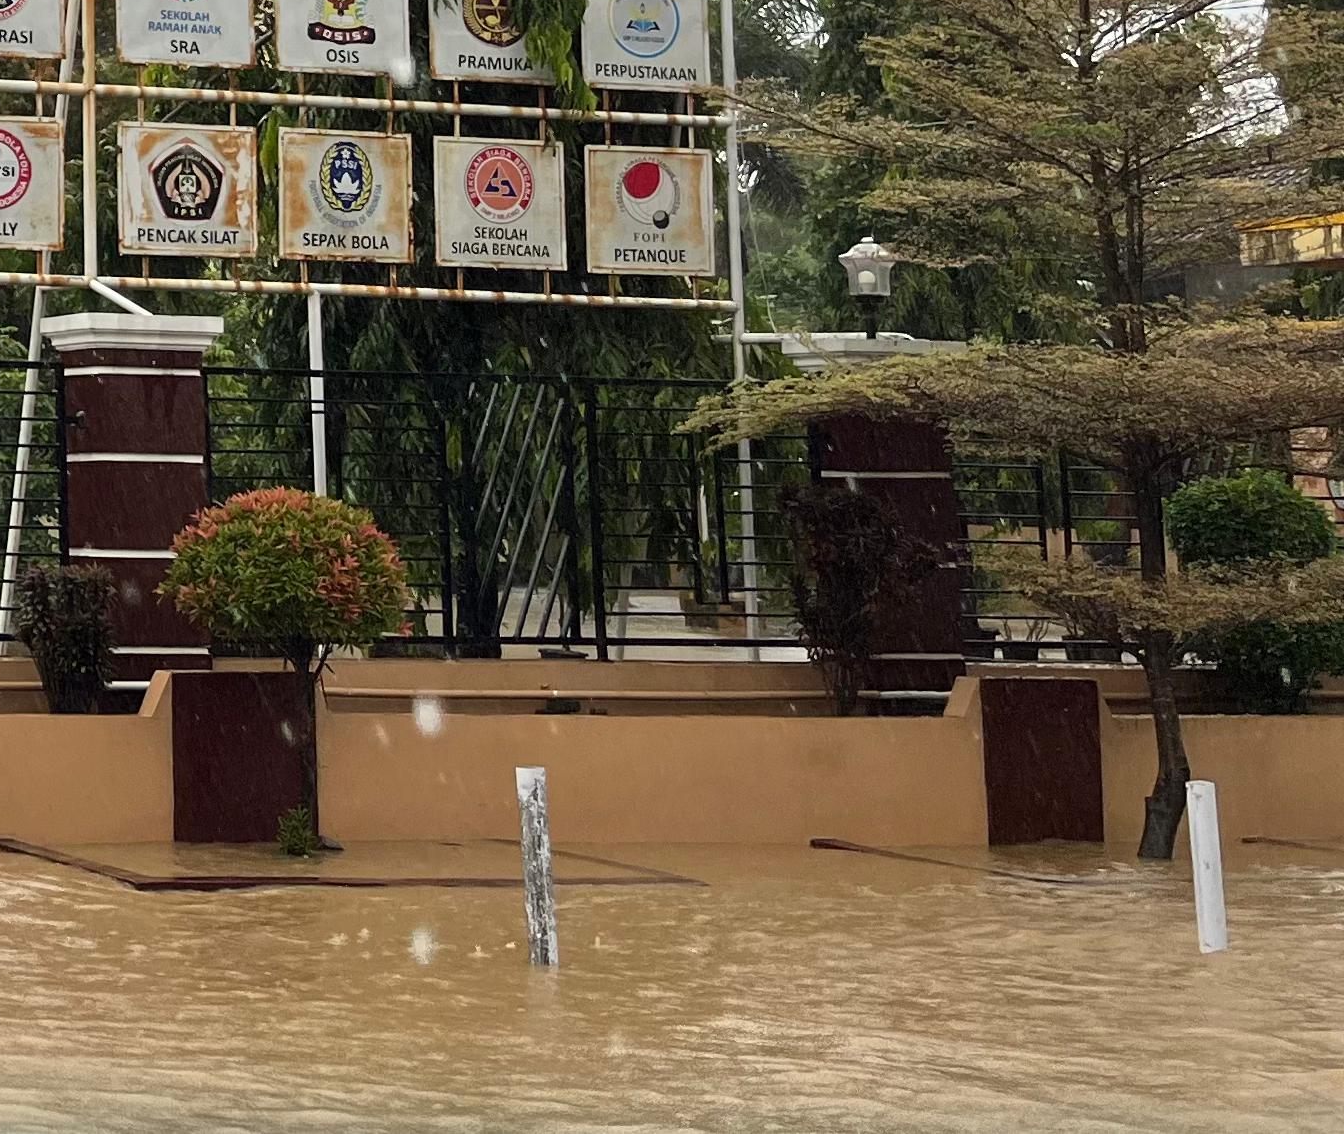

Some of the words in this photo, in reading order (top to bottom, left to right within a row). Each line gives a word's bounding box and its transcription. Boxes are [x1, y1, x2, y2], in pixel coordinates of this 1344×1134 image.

[160, 9, 210, 22] SEKOLAH
[148, 21, 188, 34] RAMAH
[190, 23, 222, 35] ANAK
[170, 40, 201, 55] SRA
[326, 49, 359, 64] OSIS
[458, 54, 534, 72] PRAMUKA
[595, 63, 698, 82] PERPUSTAKAAN
[334, 159, 358, 170] PSSI
[137, 228, 197, 244] PENCAK
[201, 229, 240, 245] SILAT
[474, 226, 528, 241] SEKOLAH
[633, 232, 666, 243] FOPI
[302, 232, 347, 249] SEPAK
[351, 235, 389, 251] BOLA
[451, 241, 489, 255] SIAGA
[492, 243, 550, 258] BENCANA
[614, 248, 687, 264] PETANQUE
